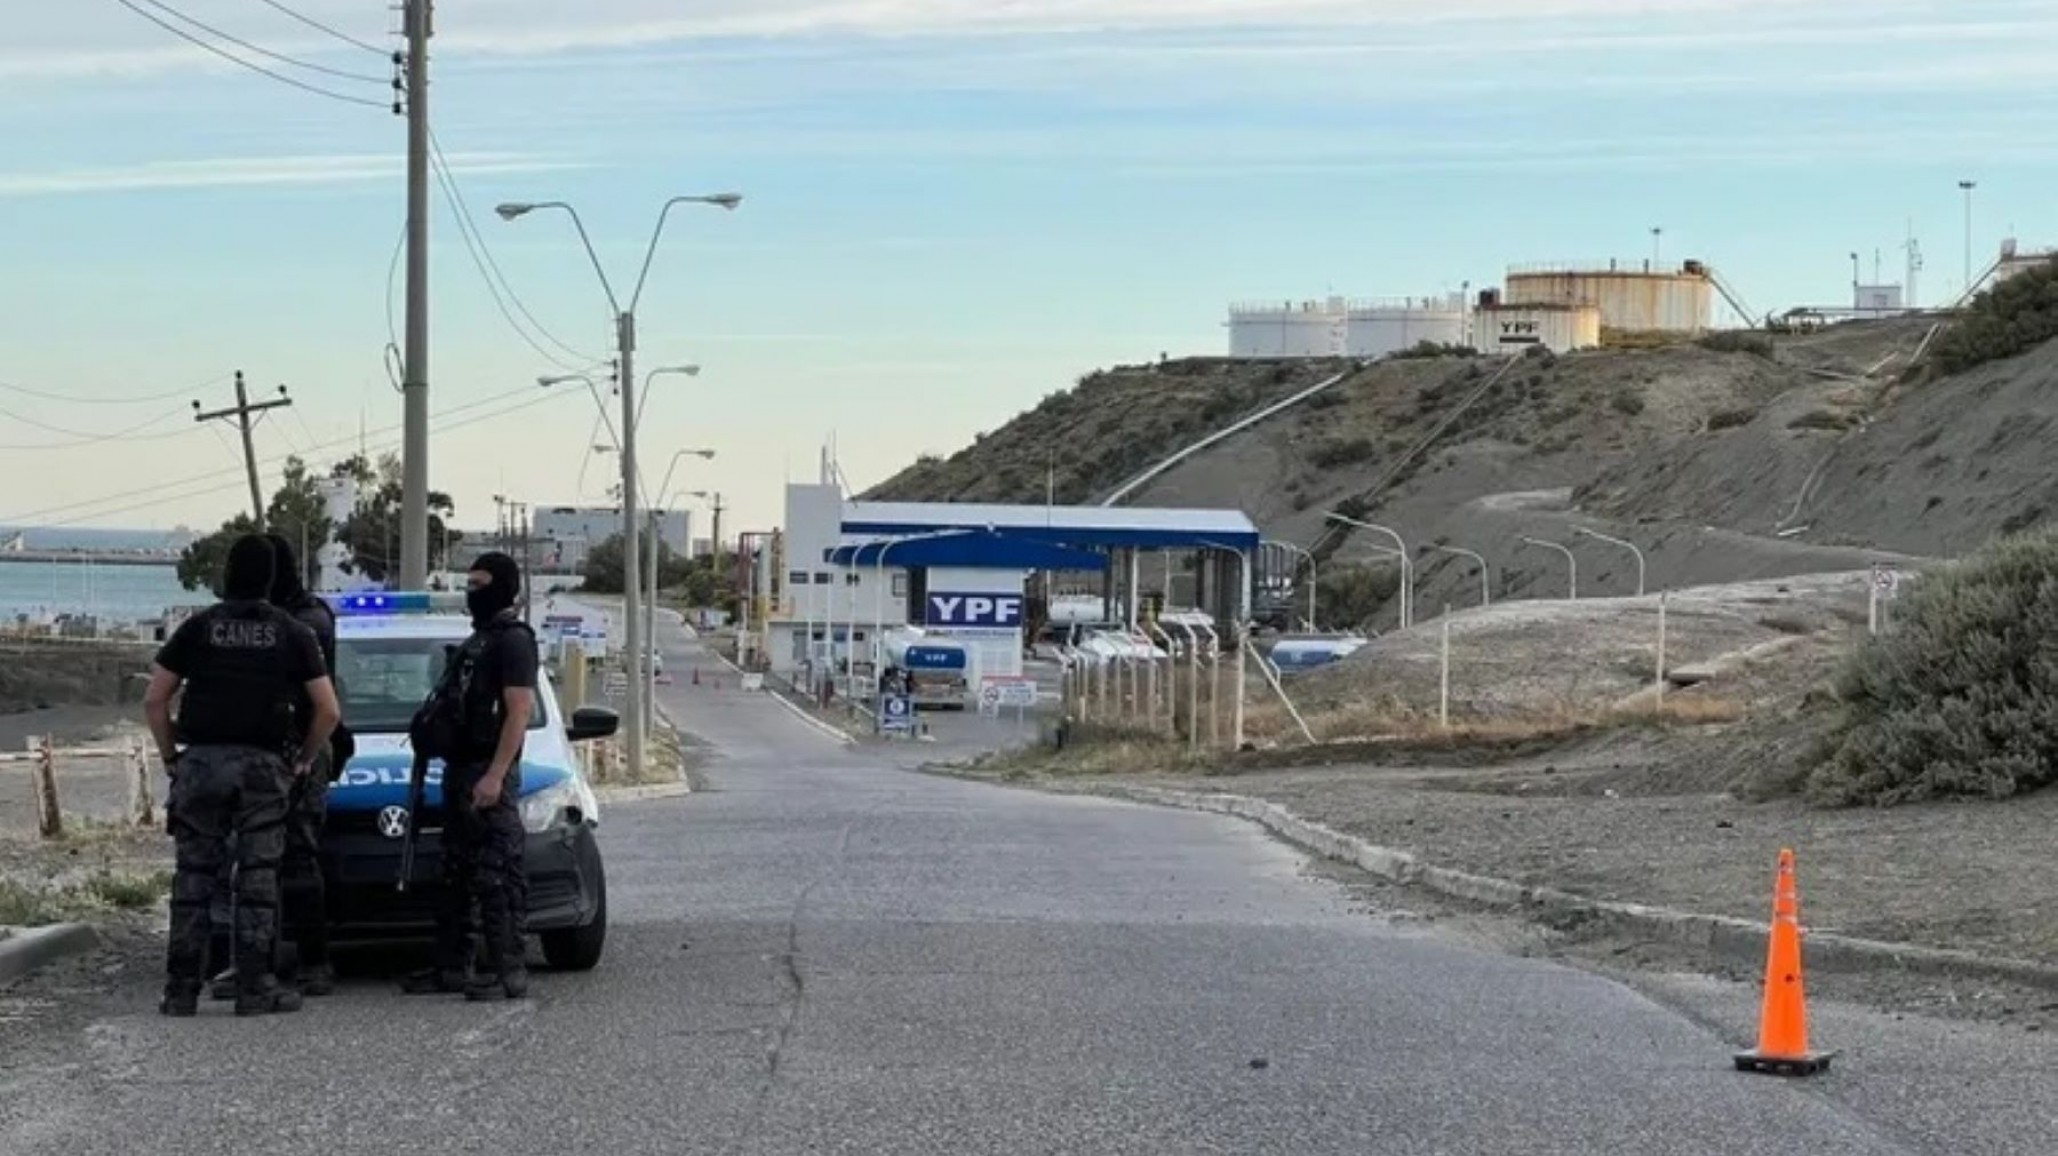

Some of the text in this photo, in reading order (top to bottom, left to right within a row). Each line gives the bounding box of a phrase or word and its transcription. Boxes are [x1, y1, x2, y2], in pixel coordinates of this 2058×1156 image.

[1500, 321, 1539, 333] YPF
[931, 597, 1020, 622] YPF
[211, 624, 276, 647] CANES
